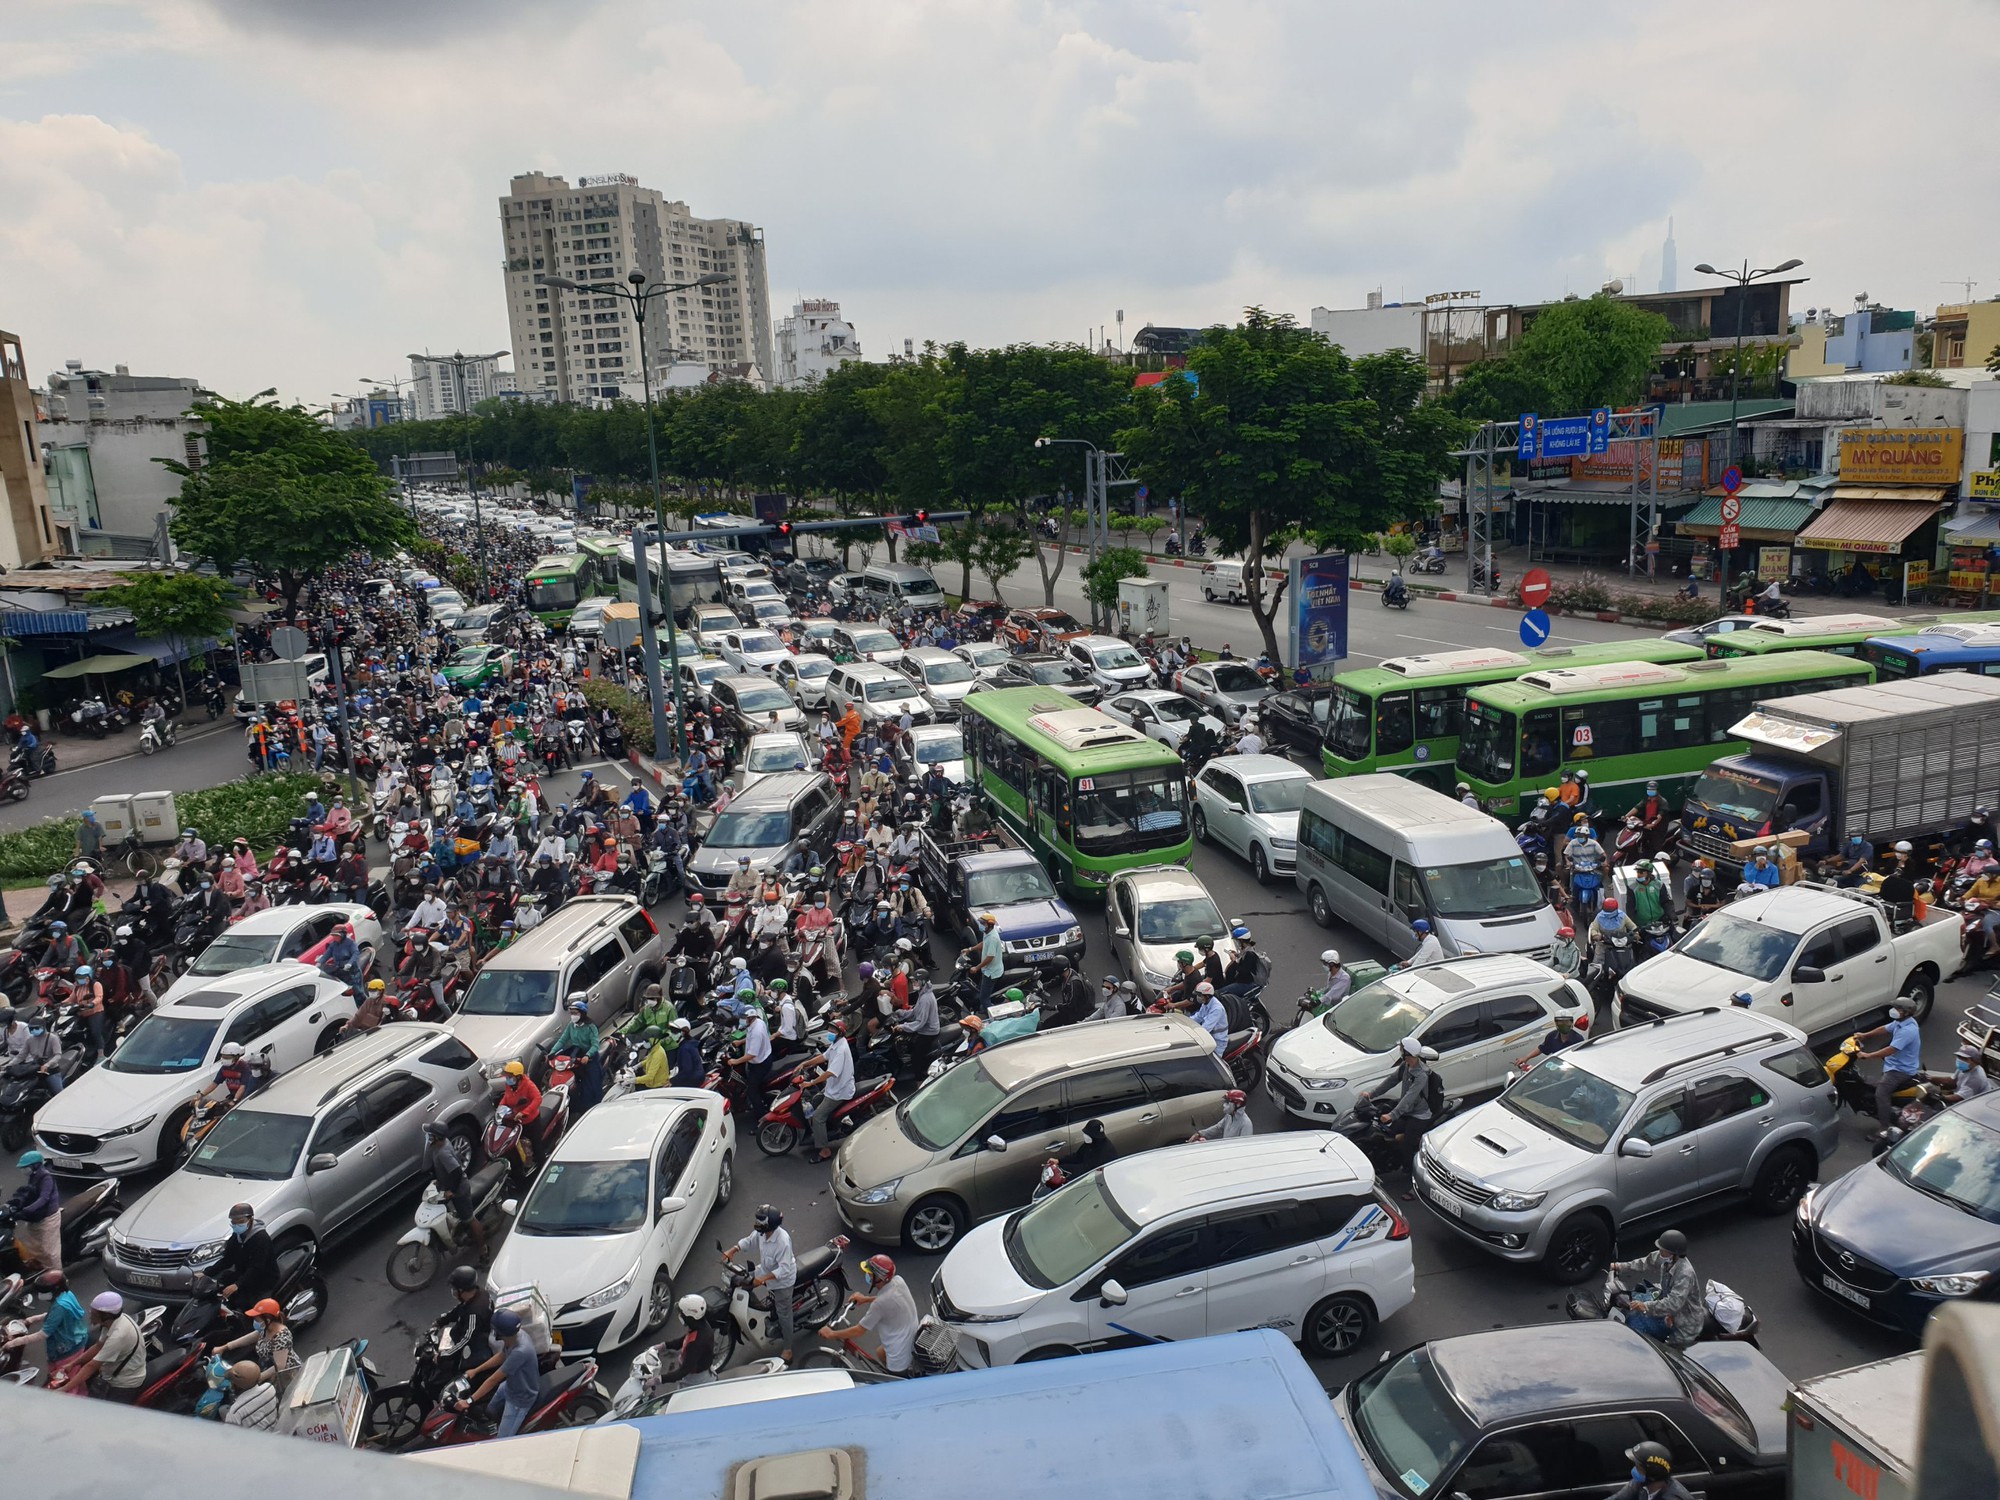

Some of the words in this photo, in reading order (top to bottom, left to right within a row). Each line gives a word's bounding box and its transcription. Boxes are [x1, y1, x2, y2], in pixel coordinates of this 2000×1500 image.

[1549, 439, 1565, 448] KHÔNG
[1574, 438, 1581, 447] XE
[1880, 444, 1942, 465] QUẢNG
[1575, 728, 1590, 742] 03
[1082, 779, 1091, 790] 91
[306, 1423, 329, 1435] CƠM
